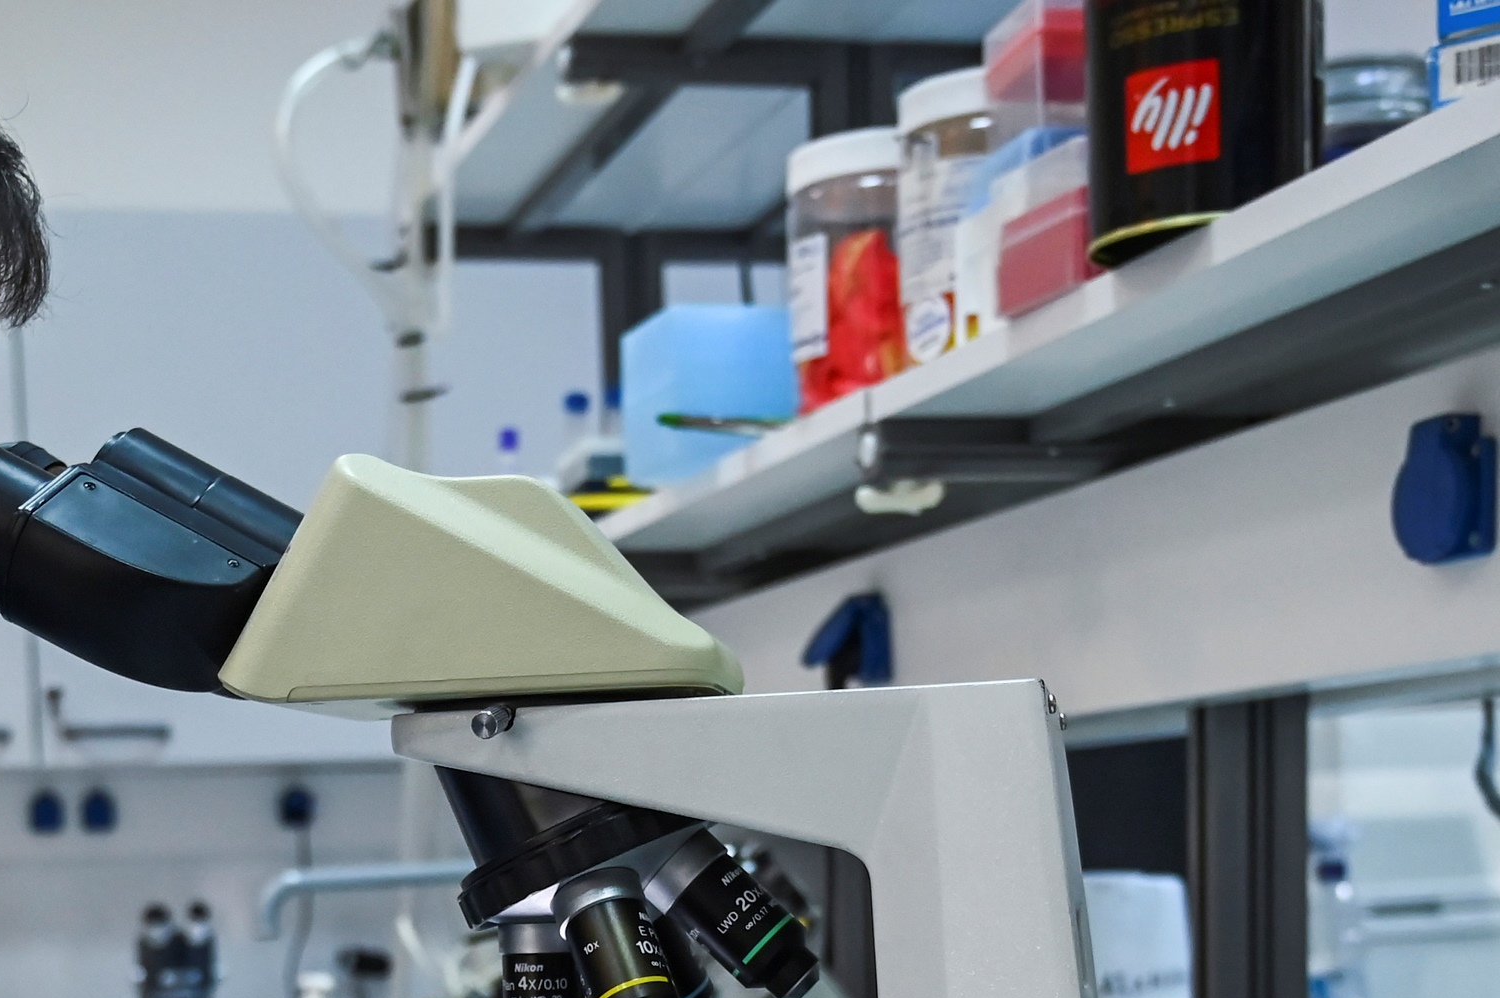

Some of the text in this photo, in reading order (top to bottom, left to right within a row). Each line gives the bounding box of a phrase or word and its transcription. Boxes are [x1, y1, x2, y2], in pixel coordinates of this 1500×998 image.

[1131, 75, 1213, 151] illy
[638, 925, 648, 937] E
[716, 911, 739, 934] LWD
[514, 963, 544, 973] Nikon
